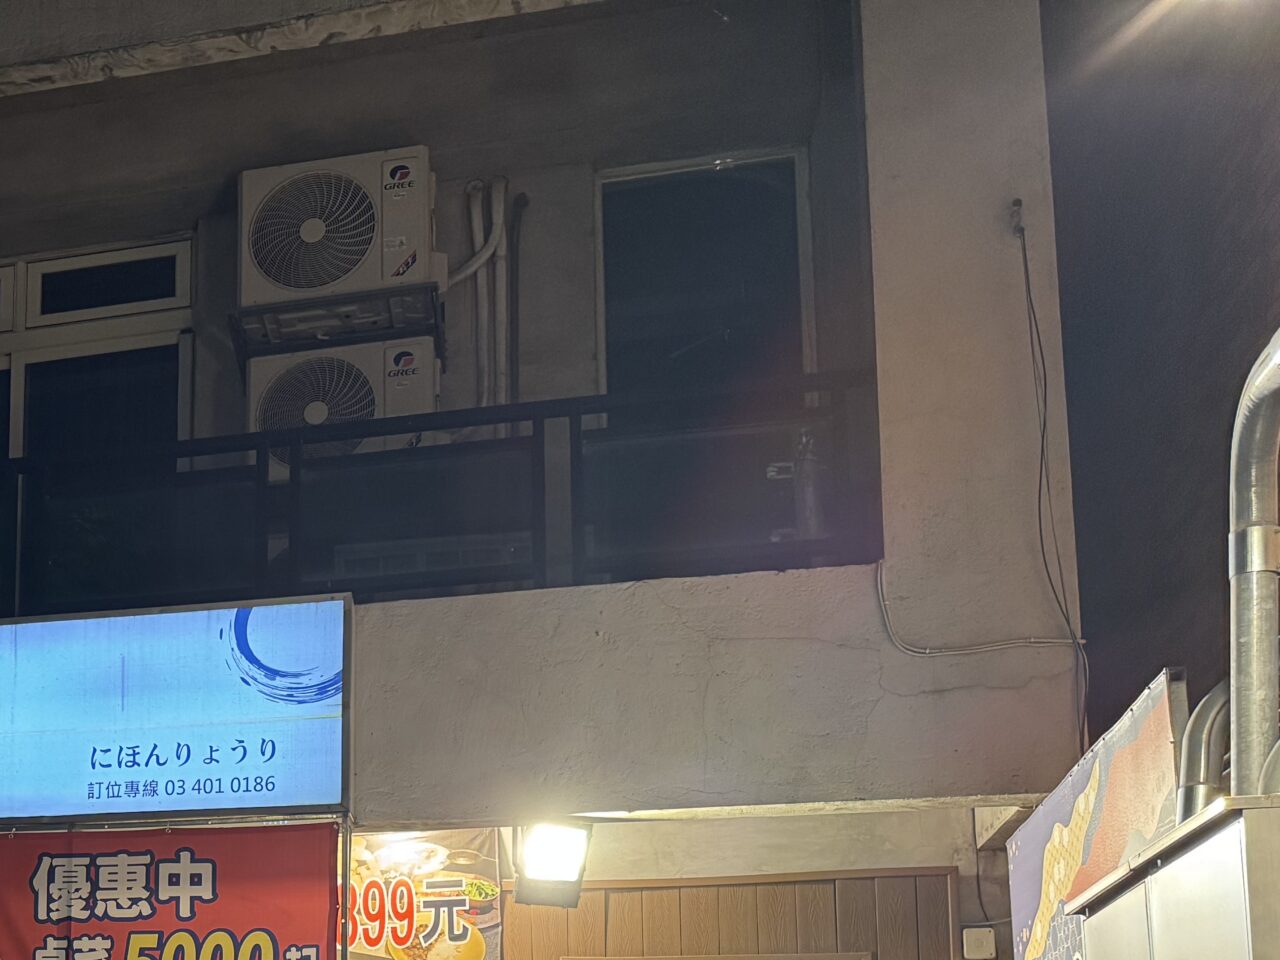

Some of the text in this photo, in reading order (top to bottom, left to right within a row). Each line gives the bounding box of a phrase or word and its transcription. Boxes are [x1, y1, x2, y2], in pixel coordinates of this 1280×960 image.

[384, 181, 416, 191] GREE
[387, 367, 420, 378] GREE
[90, 736, 277, 770] にほんりょうり
[87, 775, 276, 800] 訂位專線 03 401 0186
[30, 848, 218, 924] 優惠中
